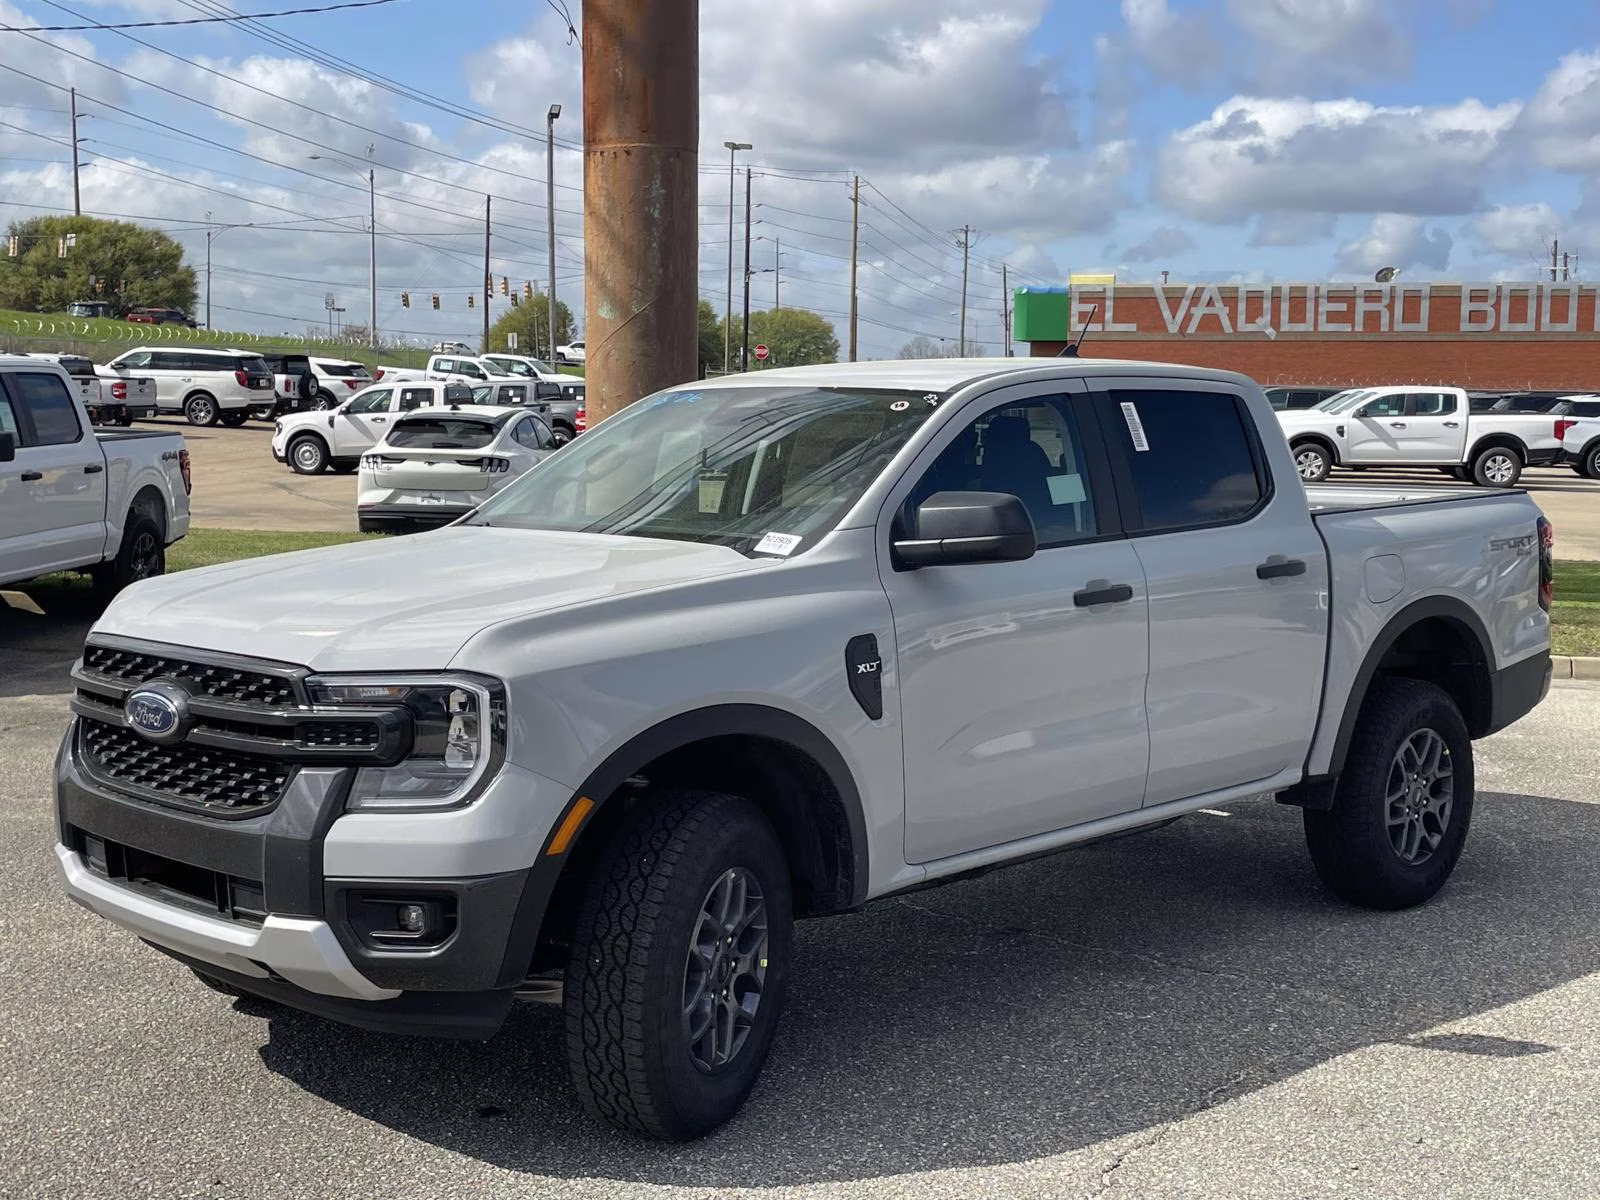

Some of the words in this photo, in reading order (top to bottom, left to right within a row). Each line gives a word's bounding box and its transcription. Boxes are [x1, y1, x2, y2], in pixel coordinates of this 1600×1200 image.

[1070, 283, 1137, 332] EL
[1152, 281, 1432, 340] VAQUERO
[1489, 535, 1534, 552] SPORT
[856, 660, 881, 674] XLT
[134, 701, 164, 728] Ford
